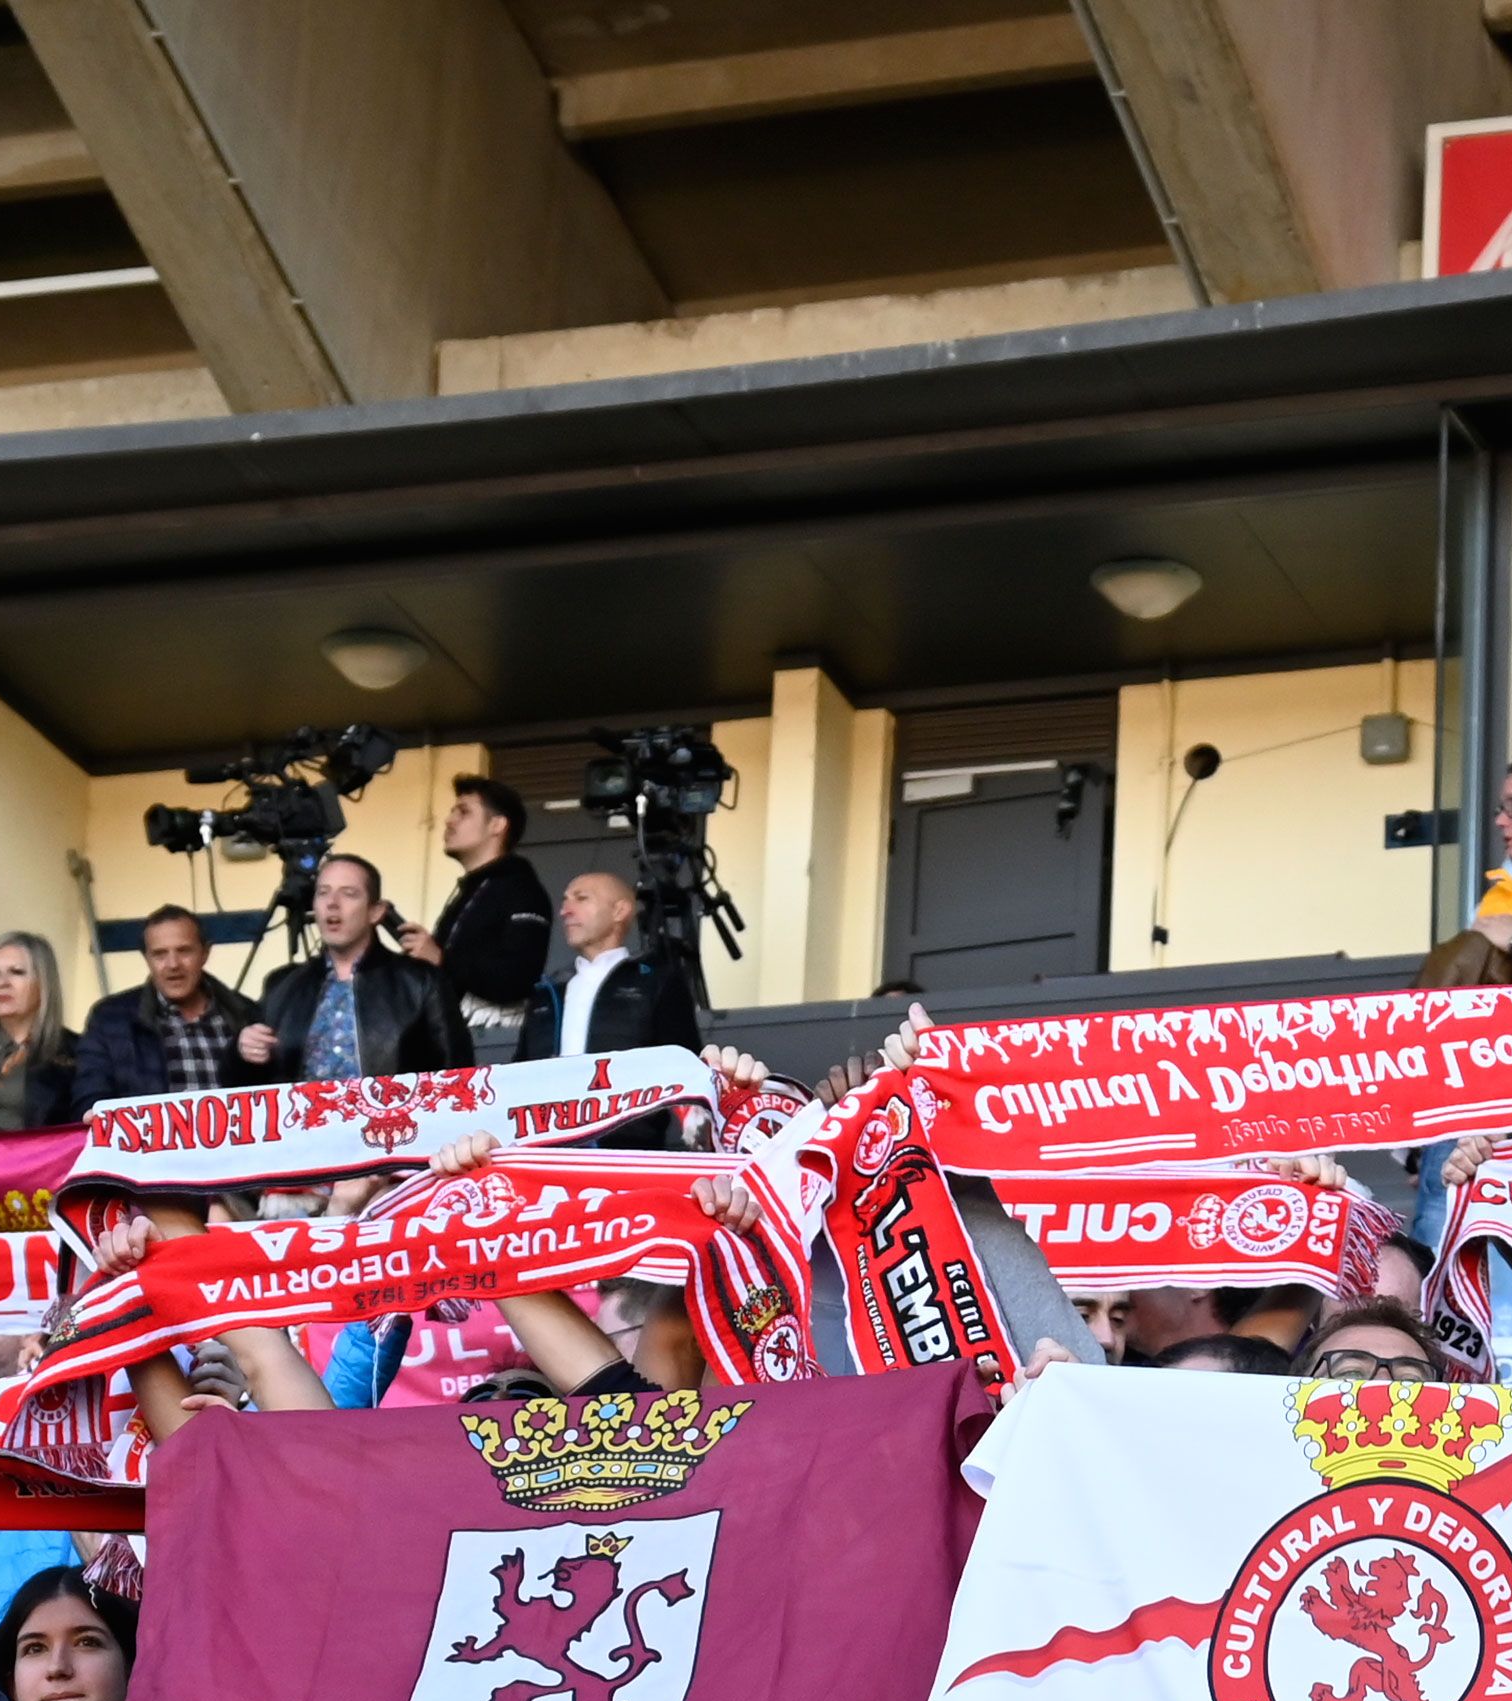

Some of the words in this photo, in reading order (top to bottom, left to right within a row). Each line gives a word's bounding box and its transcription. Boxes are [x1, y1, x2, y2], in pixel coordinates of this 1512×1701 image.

[589, 1057, 612, 1091] Y
[90, 1086, 281, 1155] LEONESA
[420, 1243, 446, 1273] Y
[466, 1212, 657, 1264] CULTURAL
[199, 1249, 413, 1305] DEPORTIVA
[1222, 1504, 1358, 1680] CULTURAL
[1367, 1497, 1395, 1527] Y
